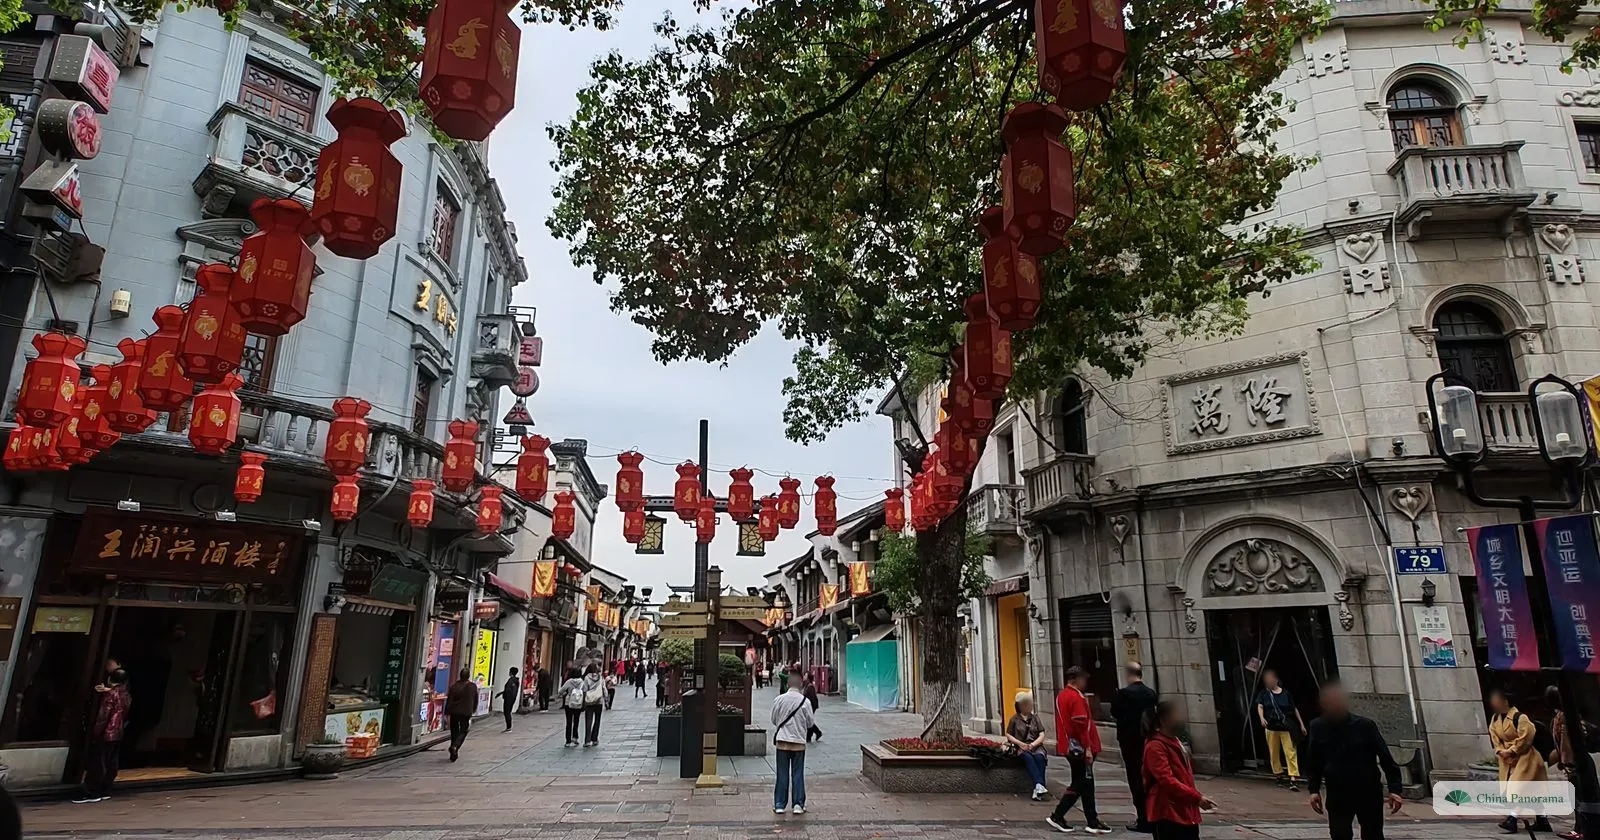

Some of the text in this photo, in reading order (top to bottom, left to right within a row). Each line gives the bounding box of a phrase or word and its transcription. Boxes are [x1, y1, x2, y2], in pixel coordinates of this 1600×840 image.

[1190, 374, 1292, 435] 萬隆
[97, 528, 262, 568] 王润兴酒楼
[1409, 555, 1431, 568] 79
[1486, 537, 1519, 657] 城乡文明大提升
[1555, 530, 1596, 659] 迎亚运 创典范
